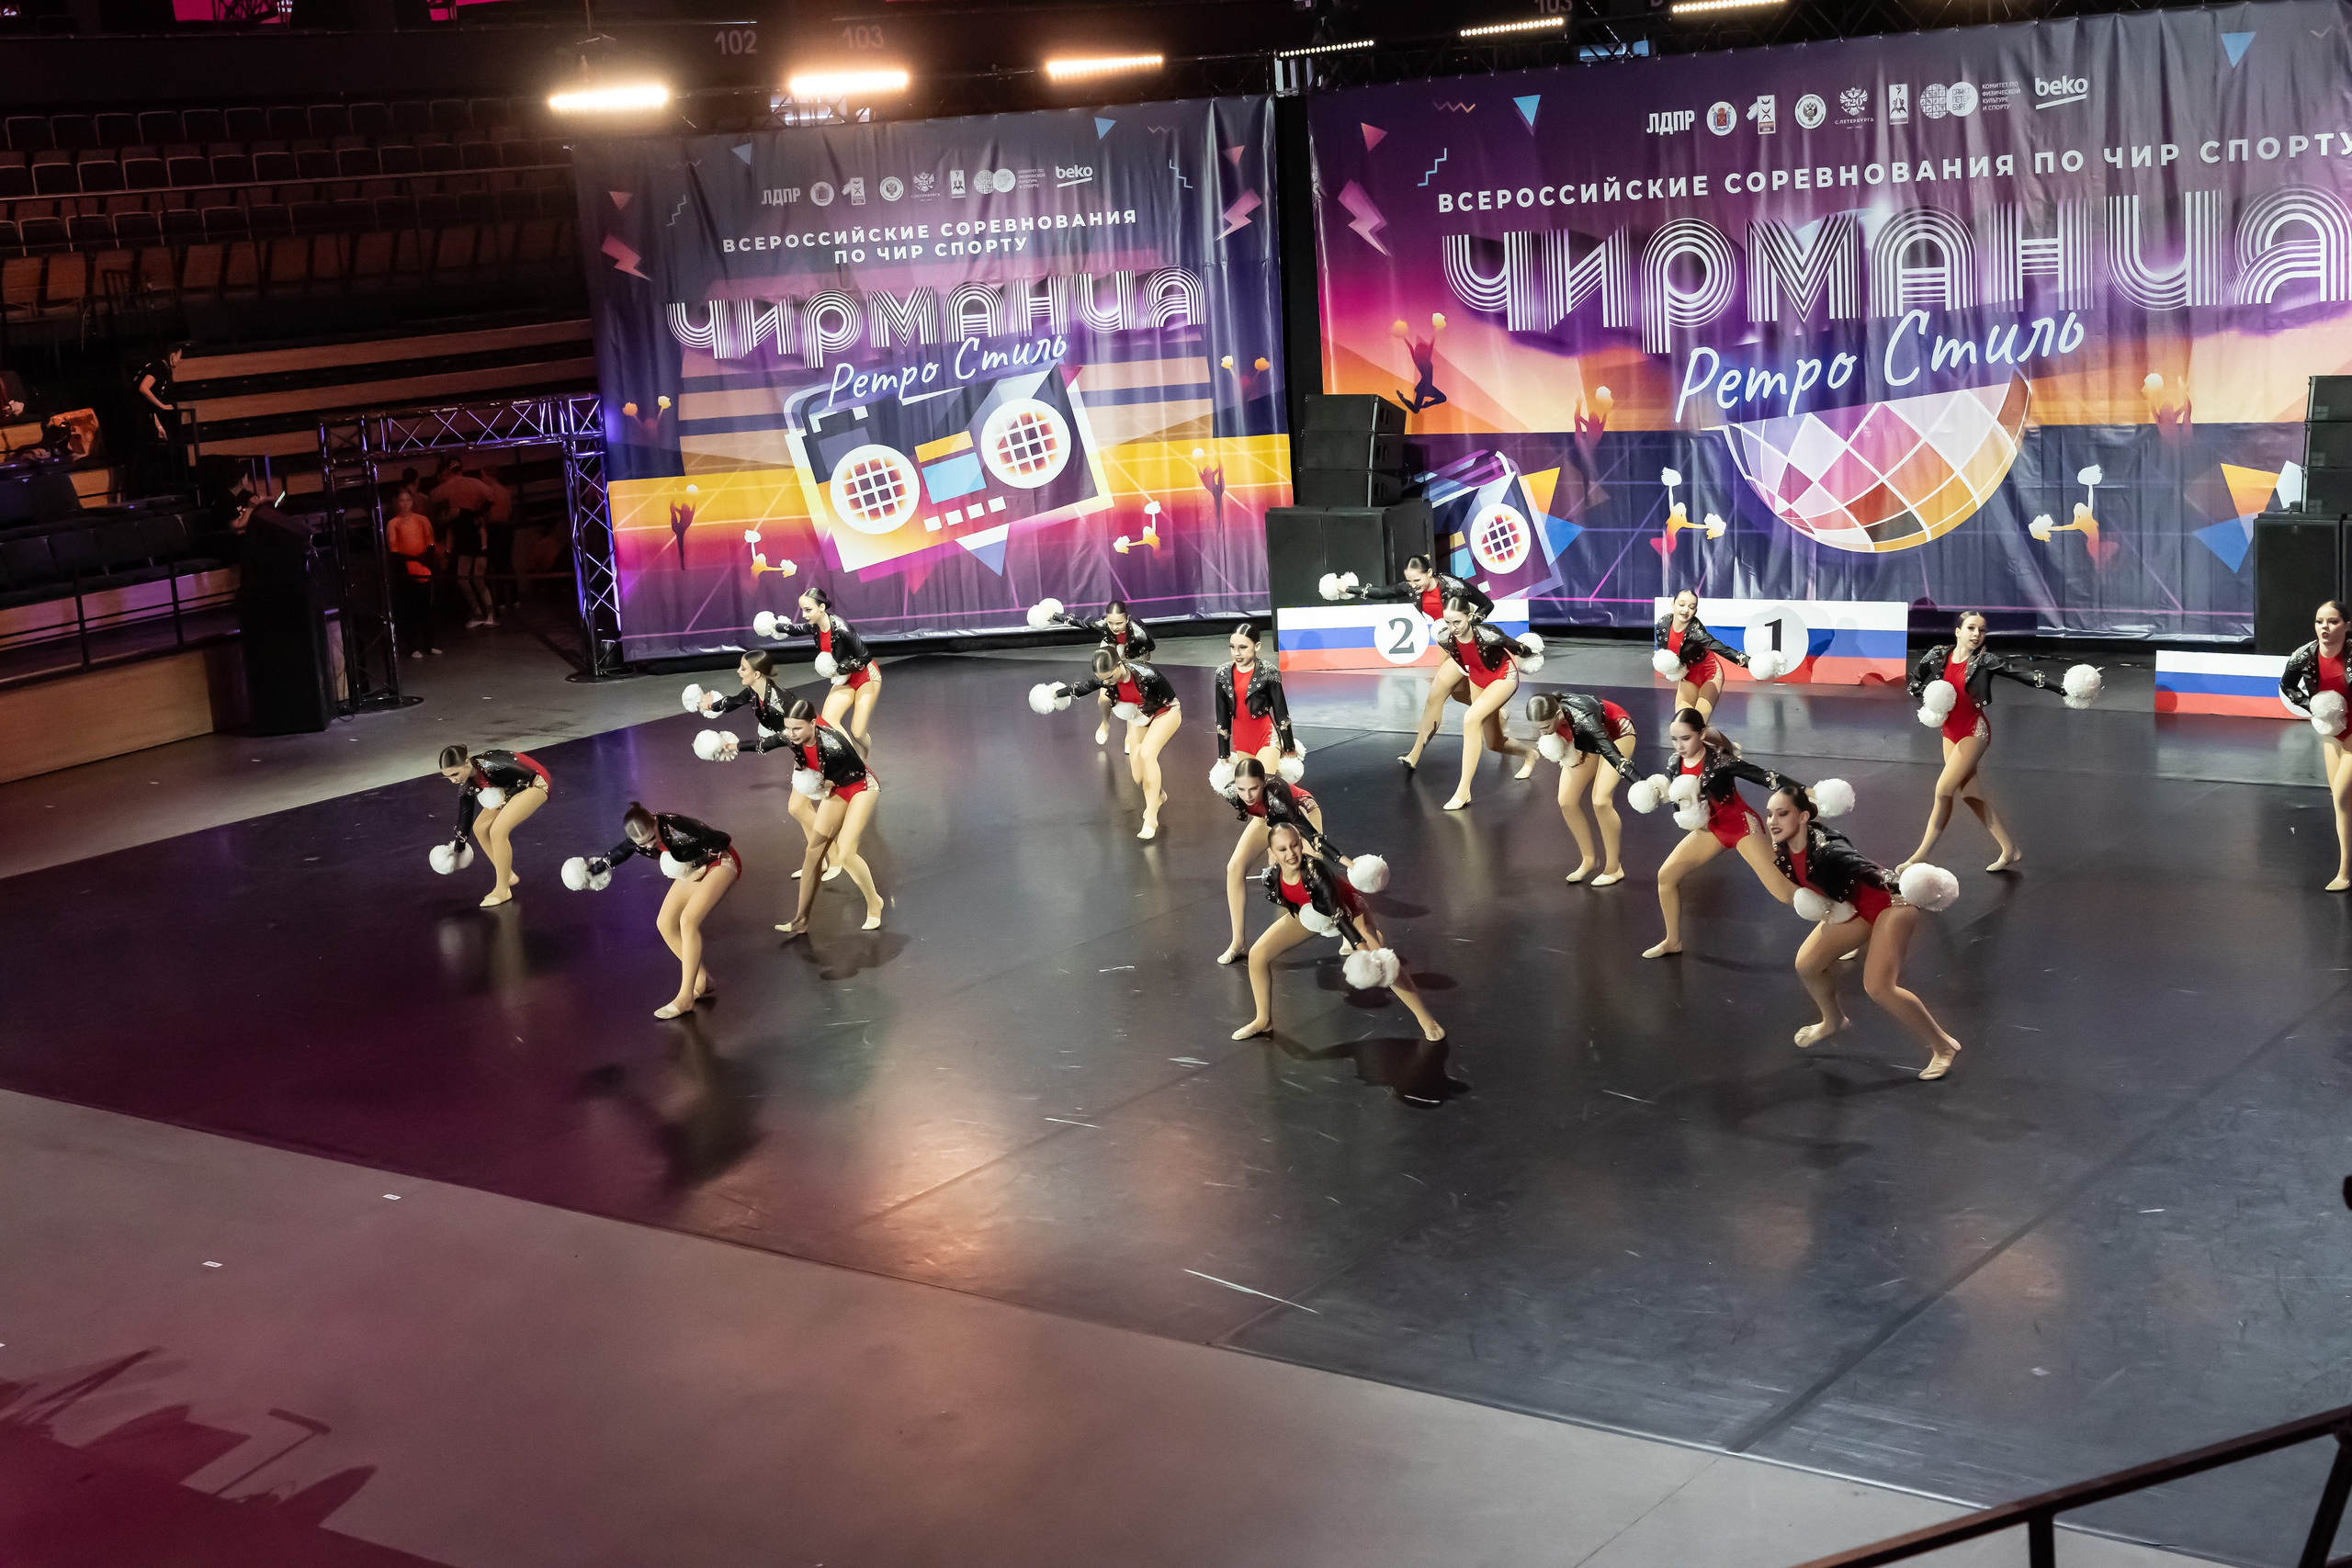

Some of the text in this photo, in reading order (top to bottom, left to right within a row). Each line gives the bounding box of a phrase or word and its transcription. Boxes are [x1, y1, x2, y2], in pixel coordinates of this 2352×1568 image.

[715, 28, 758, 55] 102
[842, 25, 885, 50] 103
[1982, 88, 2021, 96] ФИЗИЧЕСКОЙ
[2034, 75, 2088, 96] beko
[1646, 109, 1696, 136] ЛДПР
[1055, 164, 1093, 179] beko
[1438, 175, 1709, 213] ВСЕРОССИЙСКИЕ
[1724, 153, 2015, 192] СОРЕВНОВАНИЯ
[2034, 150, 2085, 175] ПО
[2104, 143, 2180, 170] ЧИР
[761, 187, 801, 207] ЛДПР
[723, 209, 1137, 253] ВСЕРОССИЙСКИЕ СОРЕВНОВАНИЯ
[834, 236, 1028, 265] ПО ЧИР СПОРТУ
[828, 334, 1068, 408] Ретро Стиль
[1675, 309, 2086, 423] Ретро Стиль
[1388, 617, 1415, 654] 2
[1764, 618, 1782, 652] 1
